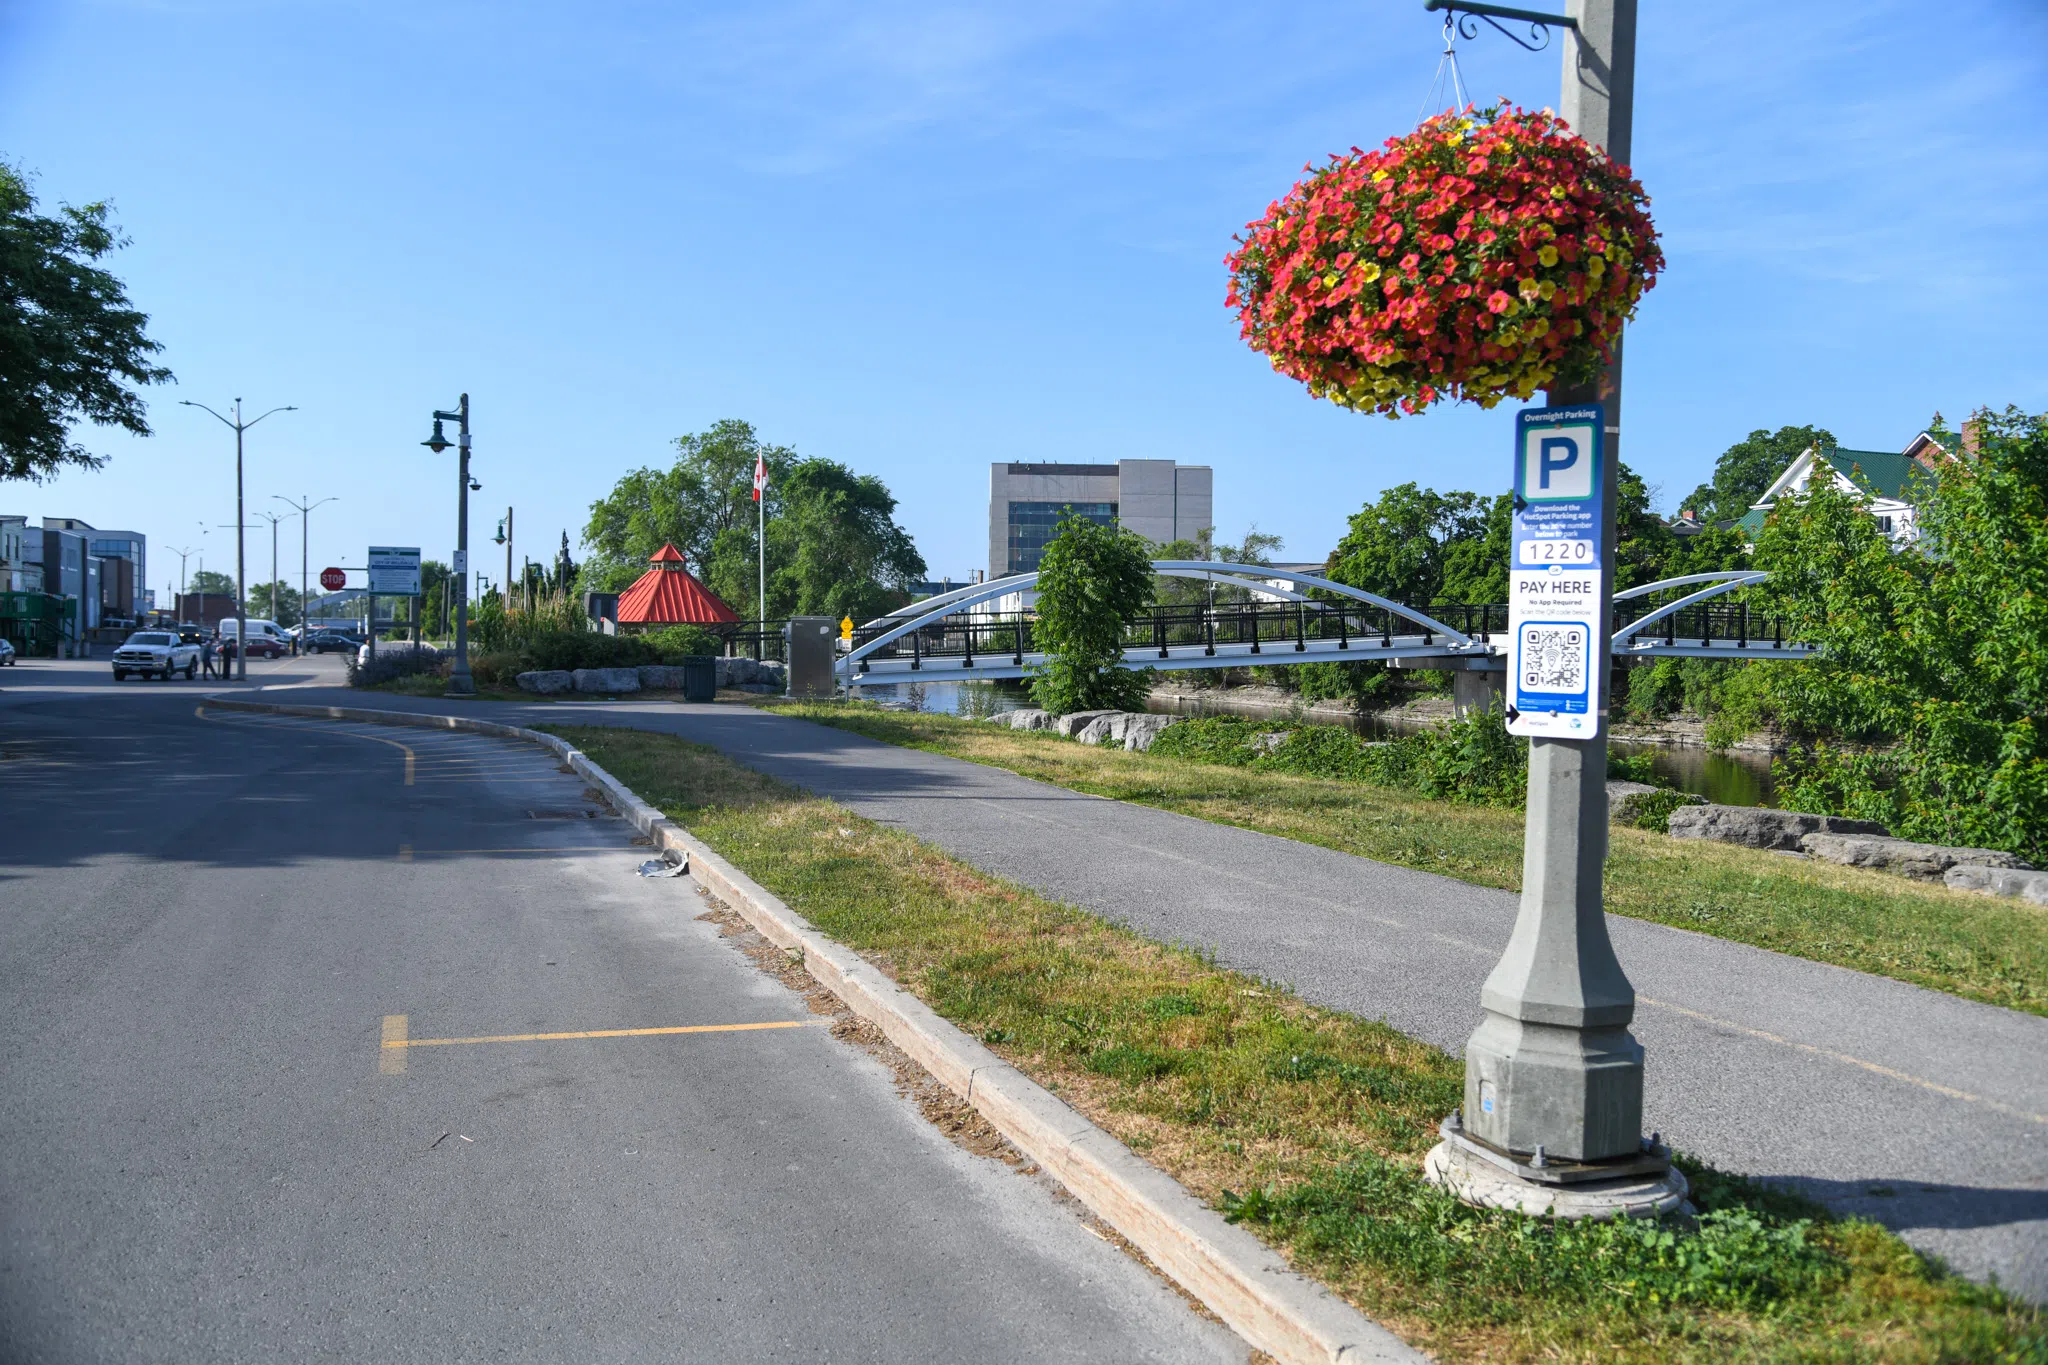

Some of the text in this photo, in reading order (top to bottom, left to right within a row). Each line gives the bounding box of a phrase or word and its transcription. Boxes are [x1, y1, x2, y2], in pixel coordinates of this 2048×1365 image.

[1524, 410, 1596, 422] Overnight Parking
[1540, 437, 1578, 489] P
[1564, 530, 1578, 538] park
[322, 574, 346, 584] STOP
[1520, 581, 1592, 594] PAY HERE
